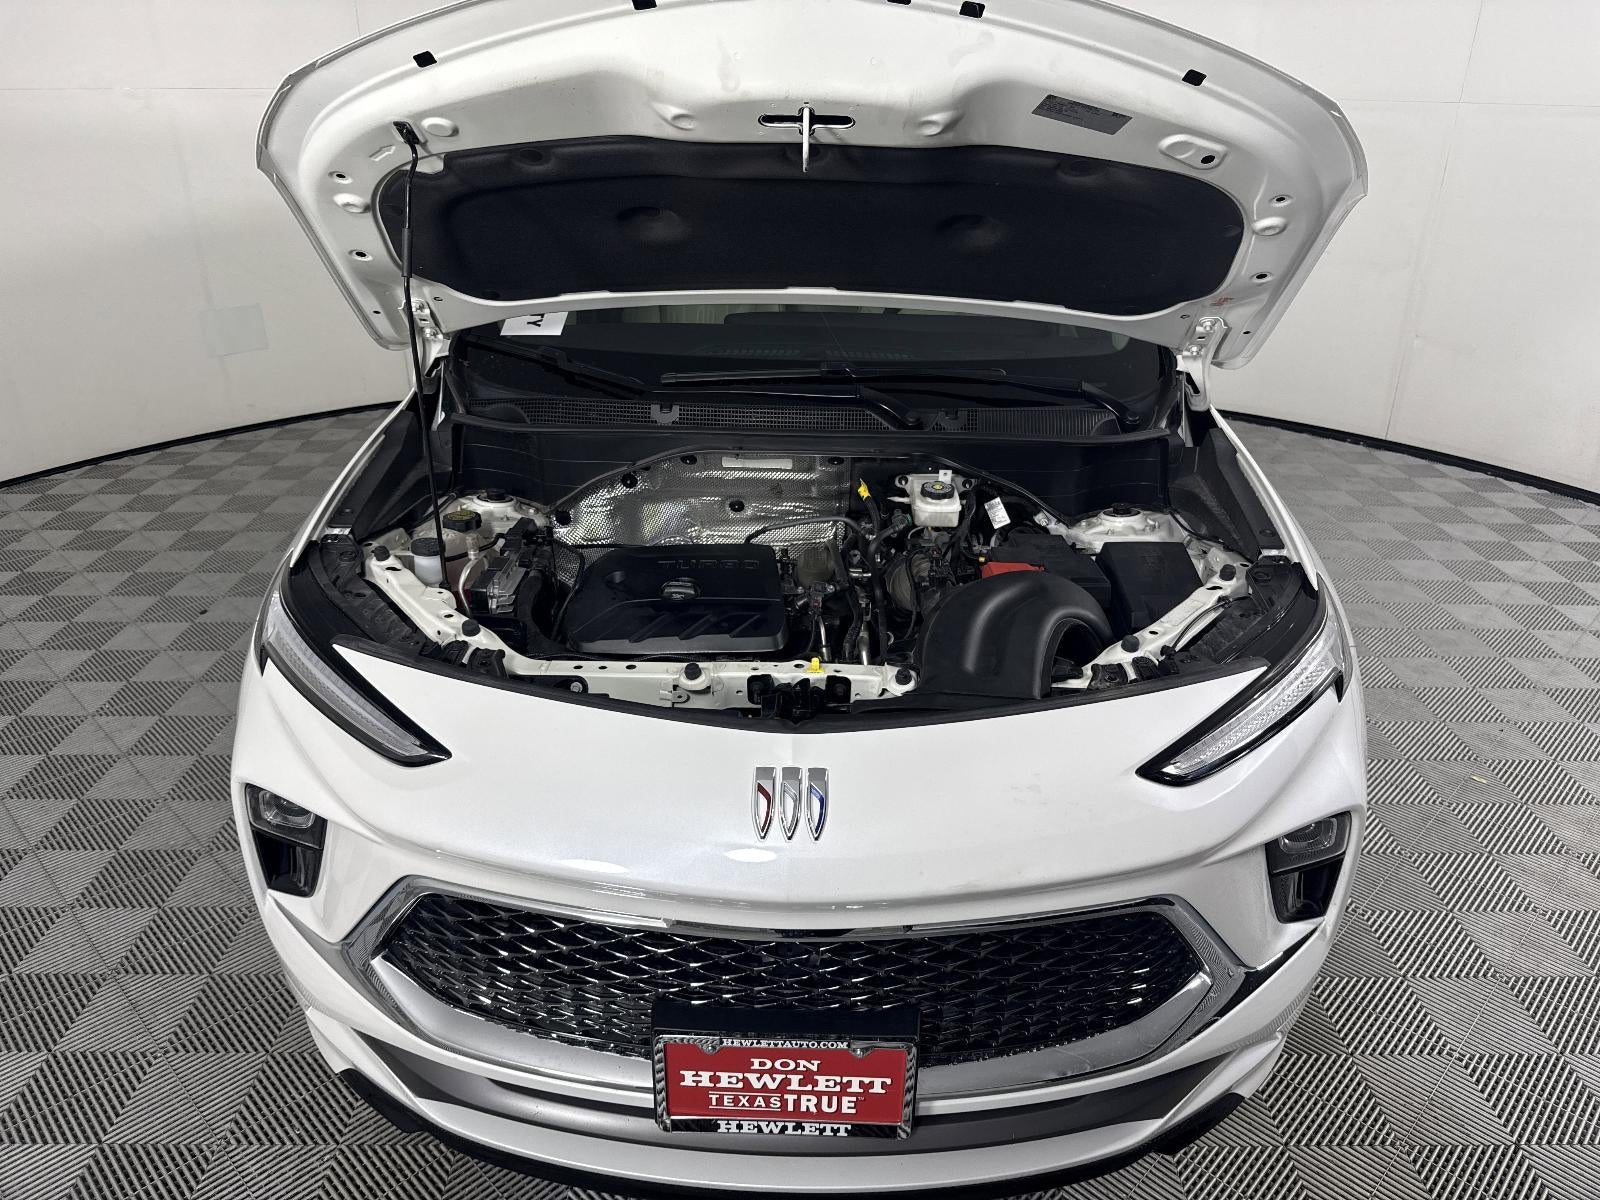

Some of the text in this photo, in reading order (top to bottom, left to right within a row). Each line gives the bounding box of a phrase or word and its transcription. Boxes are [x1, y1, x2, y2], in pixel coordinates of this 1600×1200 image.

[657, 559, 760, 570] TURBO
[722, 1038, 848, 1049] HEWLETTAUTO.COM
[750, 1058, 821, 1072] DON
[679, 1070, 892, 1094] HEWLETT
[716, 1120, 851, 1137] HEWLETT
